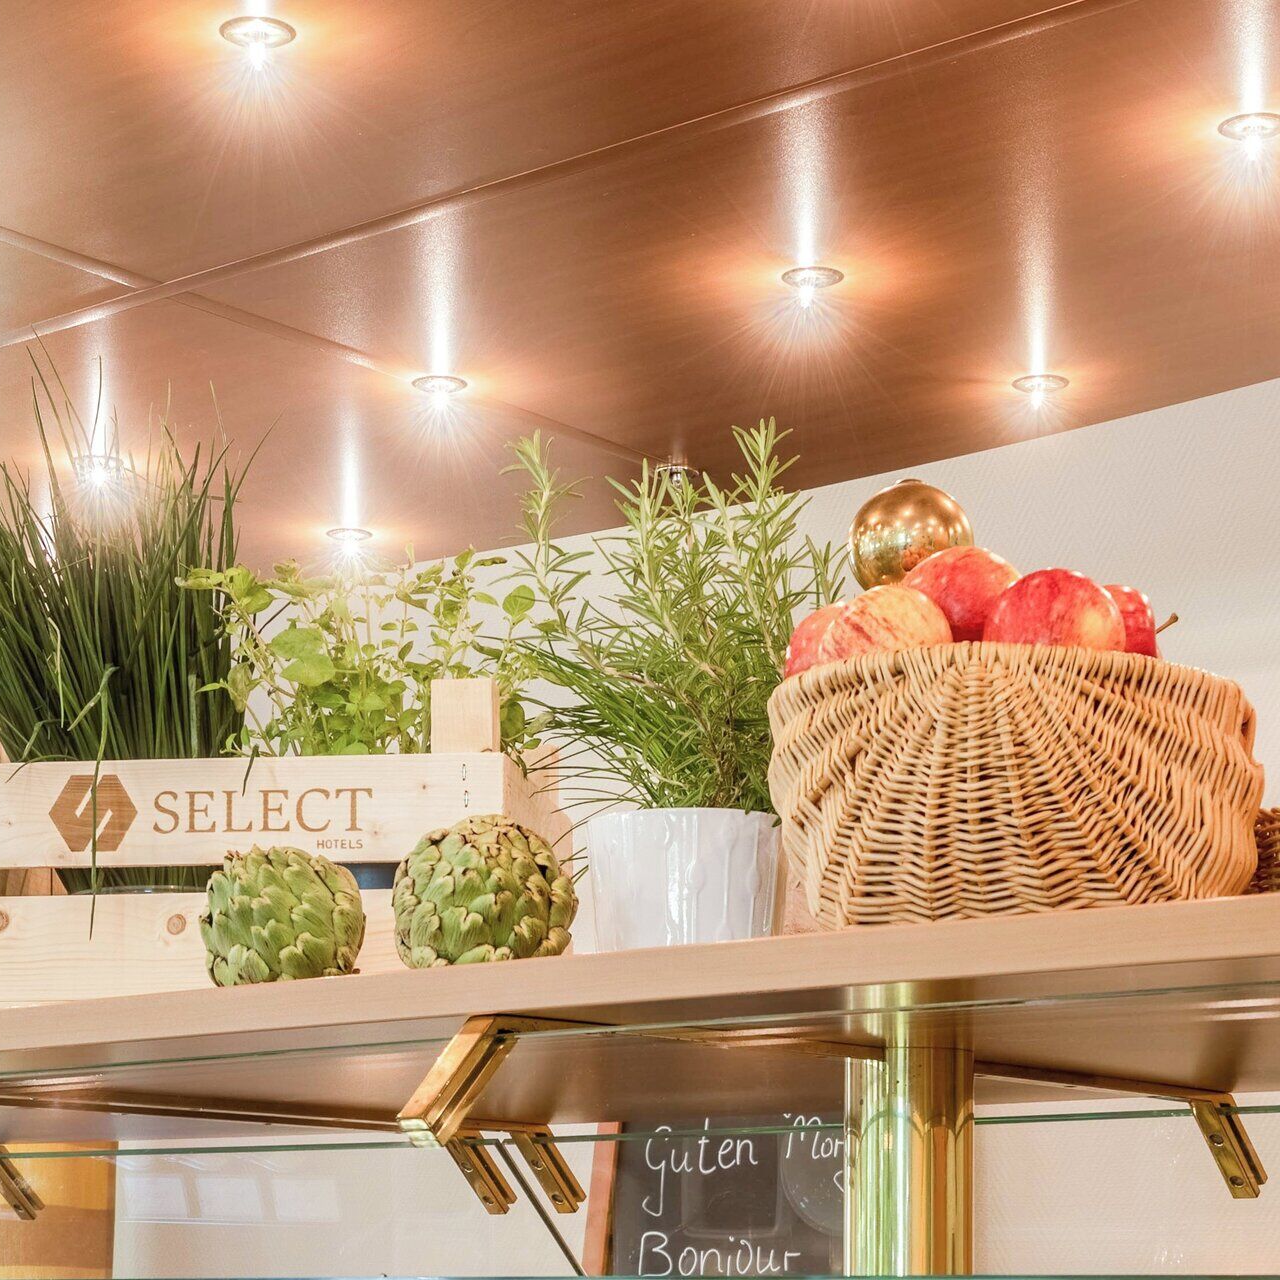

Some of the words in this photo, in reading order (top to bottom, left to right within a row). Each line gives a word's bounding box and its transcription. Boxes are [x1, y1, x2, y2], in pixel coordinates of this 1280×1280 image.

[151, 787, 374, 835] SELECT
[316, 839, 364, 850] HOTELS
[642, 1117, 758, 1217] Guten
[782, 1112, 845, 1193] Mor
